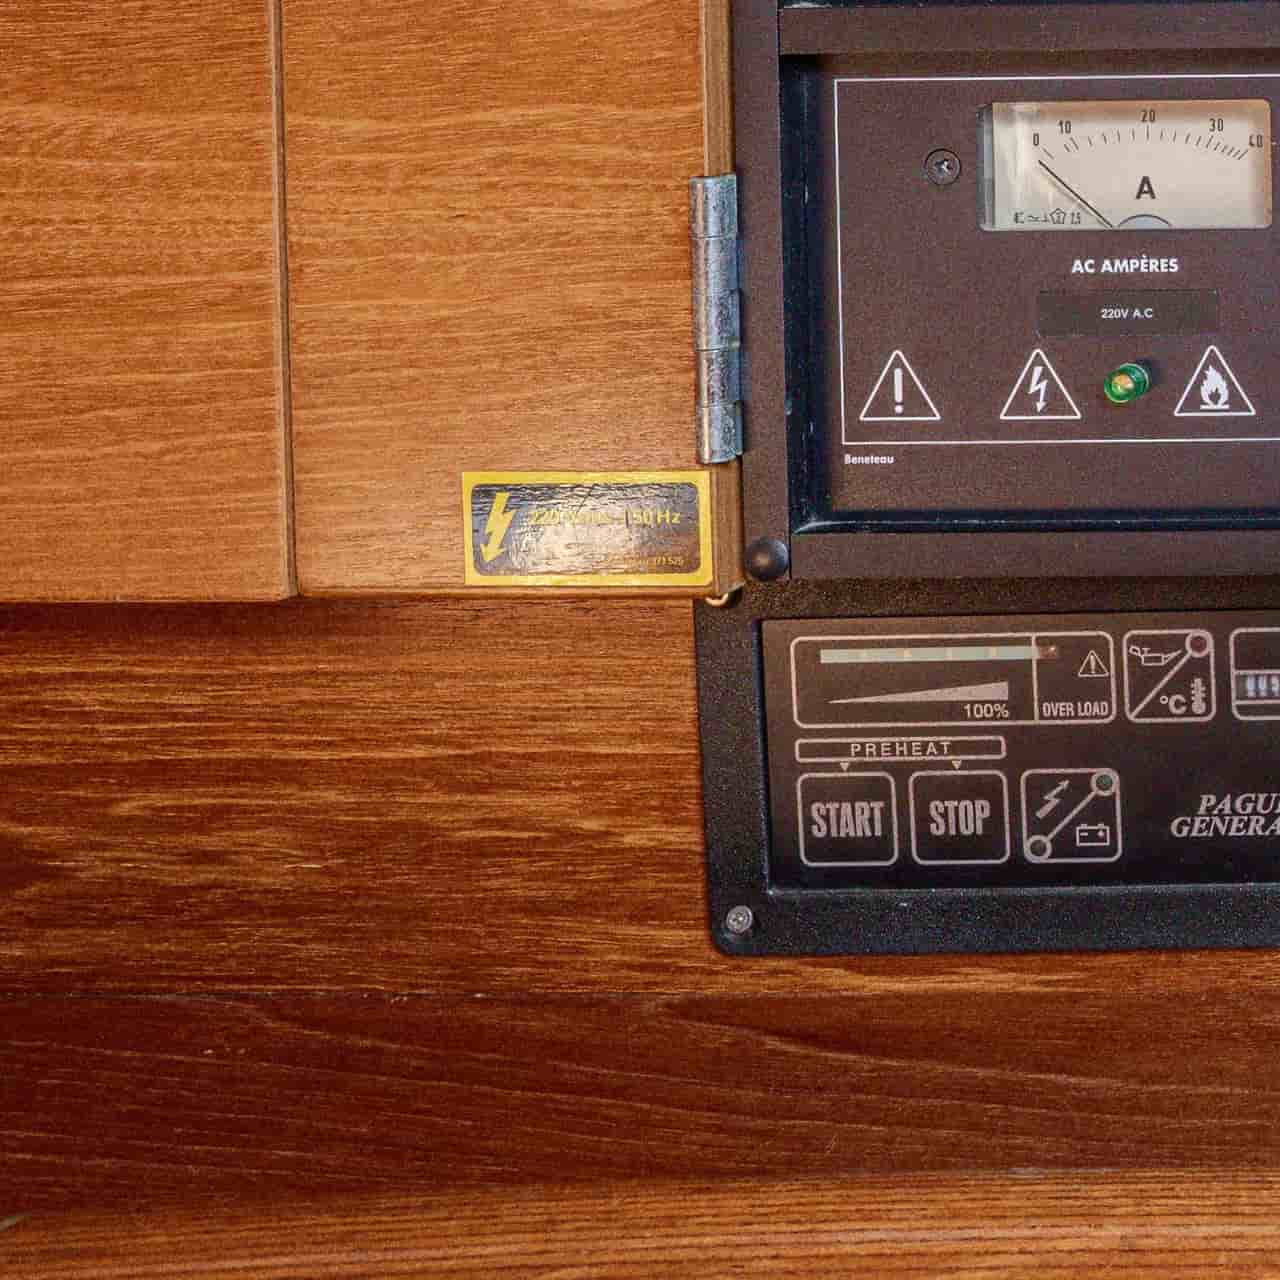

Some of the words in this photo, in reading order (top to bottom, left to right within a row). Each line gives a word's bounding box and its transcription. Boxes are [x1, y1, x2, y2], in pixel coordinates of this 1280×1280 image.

[1058, 120, 1071, 134] 10
[1141, 109, 1156, 123] 20
[1209, 118, 1224, 132] 30
[1135, 177, 1156, 200] A
[1071, 258, 1096, 273] AC
[1101, 254, 1179, 273] AMPÈRES
[1101, 308, 1128, 319] 220V
[1133, 308, 1153, 319] A.C
[844, 454, 894, 465] Beneteau
[964, 703, 1009, 718] 100%
[1043, 701, 1072, 718] OVER
[1076, 700, 1109, 717] LOAD
[851, 742, 953, 758] PREHEAT
[812, 802, 884, 838] START
[930, 801, 989, 836] STOP
